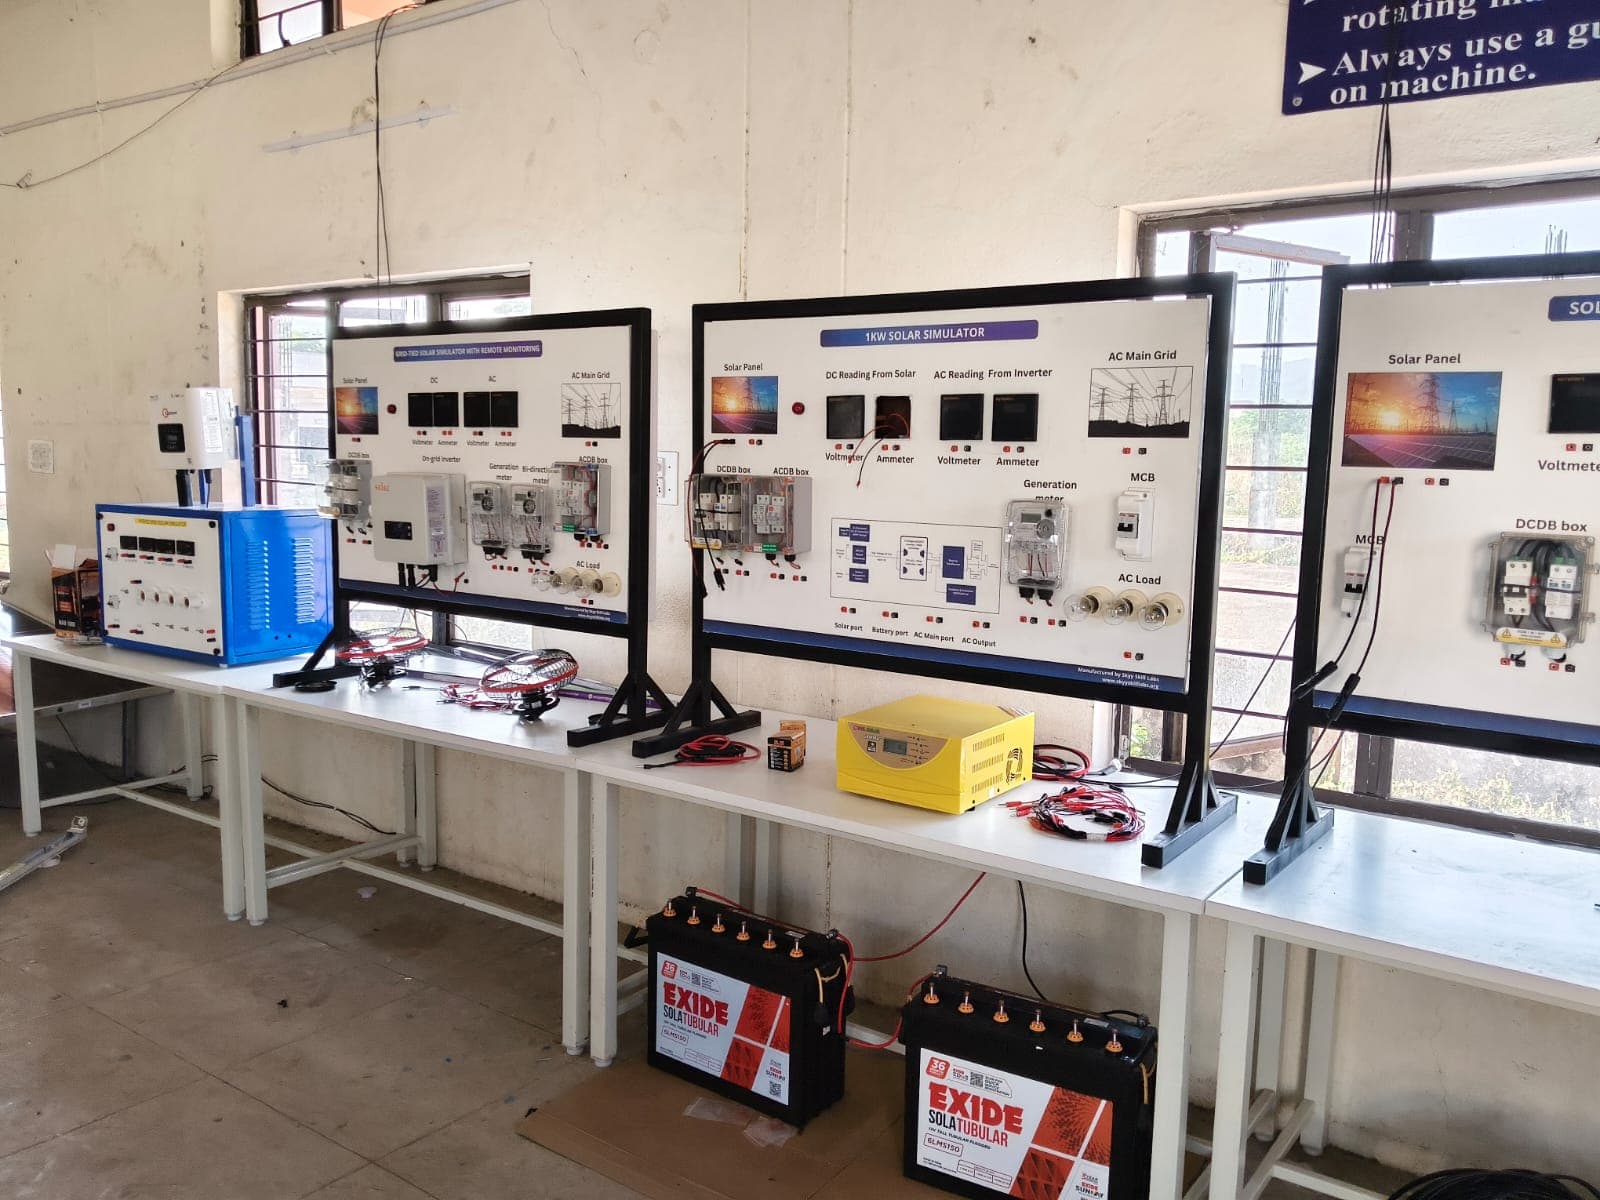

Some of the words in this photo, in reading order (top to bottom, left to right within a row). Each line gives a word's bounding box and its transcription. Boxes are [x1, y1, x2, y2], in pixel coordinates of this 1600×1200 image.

[1342, 0, 1477, 32] rotating
[1332, 43, 1452, 75] Always
[1465, 33, 1522, 57] use
[1533, 28, 1555, 48] a
[1330, 84, 1367, 105] on
[1380, 62, 1536, 99] machine.
[866, 331, 886, 342] 1KW
[888, 330, 921, 341] SOLAR
[923, 327, 985, 340] SIMULATOR
[420, 349, 435, 357] SOLAR
[436, 347, 466, 356] SIMULATOR
[467, 346, 480, 354] WITH
[481, 346, 503, 354] REMOTE
[503, 344, 541, 353] MONITORING
[1108, 352, 1123, 361] AC
[1125, 351, 1152, 361] Main
[1154, 350, 1177, 360] Grid
[1388, 354, 1421, 365] Solar
[1425, 353, 1461, 364] Panel
[723, 363, 741, 372] Solar
[743, 362, 763, 372] Panel
[582, 372, 596, 380] Main
[597, 371, 610, 379] Grid
[825, 371, 837, 380] DC
[839, 370, 871, 382] Reading
[872, 370, 893, 379] From
[894, 368, 917, 378] Solar
[933, 371, 946, 380] AC
[948, 370, 984, 381] Reading
[988, 369, 1012, 378] From
[1014, 368, 1053, 378] Inverter
[578, 456, 596, 464] ACDB
[825, 452, 864, 462] Voltmeter
[876, 455, 914, 464] Ammeter
[937, 456, 982, 466] Voltmeter
[996, 456, 1040, 467] Ammeter
[489, 463, 519, 471] Generation
[717, 466, 737, 474] DCDB
[738, 466, 751, 474] box
[773, 467, 794, 476] ACDB
[796, 468, 809, 476] box
[1130, 472, 1156, 482] MCB
[1023, 479, 1078, 490] Generation
[1515, 518, 1557, 531] DCDB
[1561, 520, 1588, 532] box
[1355, 534, 1386, 544] MCB
[586, 561, 600, 570] Load
[1118, 574, 1134, 582] AC
[1136, 574, 1161, 585] Load
[834, 622, 849, 630] Solar
[850, 624, 863, 633] port
[872, 626, 895, 637] Battery
[896, 629, 908, 638] port
[924, 632, 940, 640] Main
[940, 634, 954, 643] port
[962, 636, 972, 644] AC
[972, 637, 996, 648] Output
[664, 981, 729, 1026] EXIDE
[664, 1004, 719, 1038] SOLATUBULAR
[932, 1060, 946, 1071] 36
[928, 1082, 1024, 1135] EXIDE
[928, 1110, 1008, 1148] SOLATUBULAR
